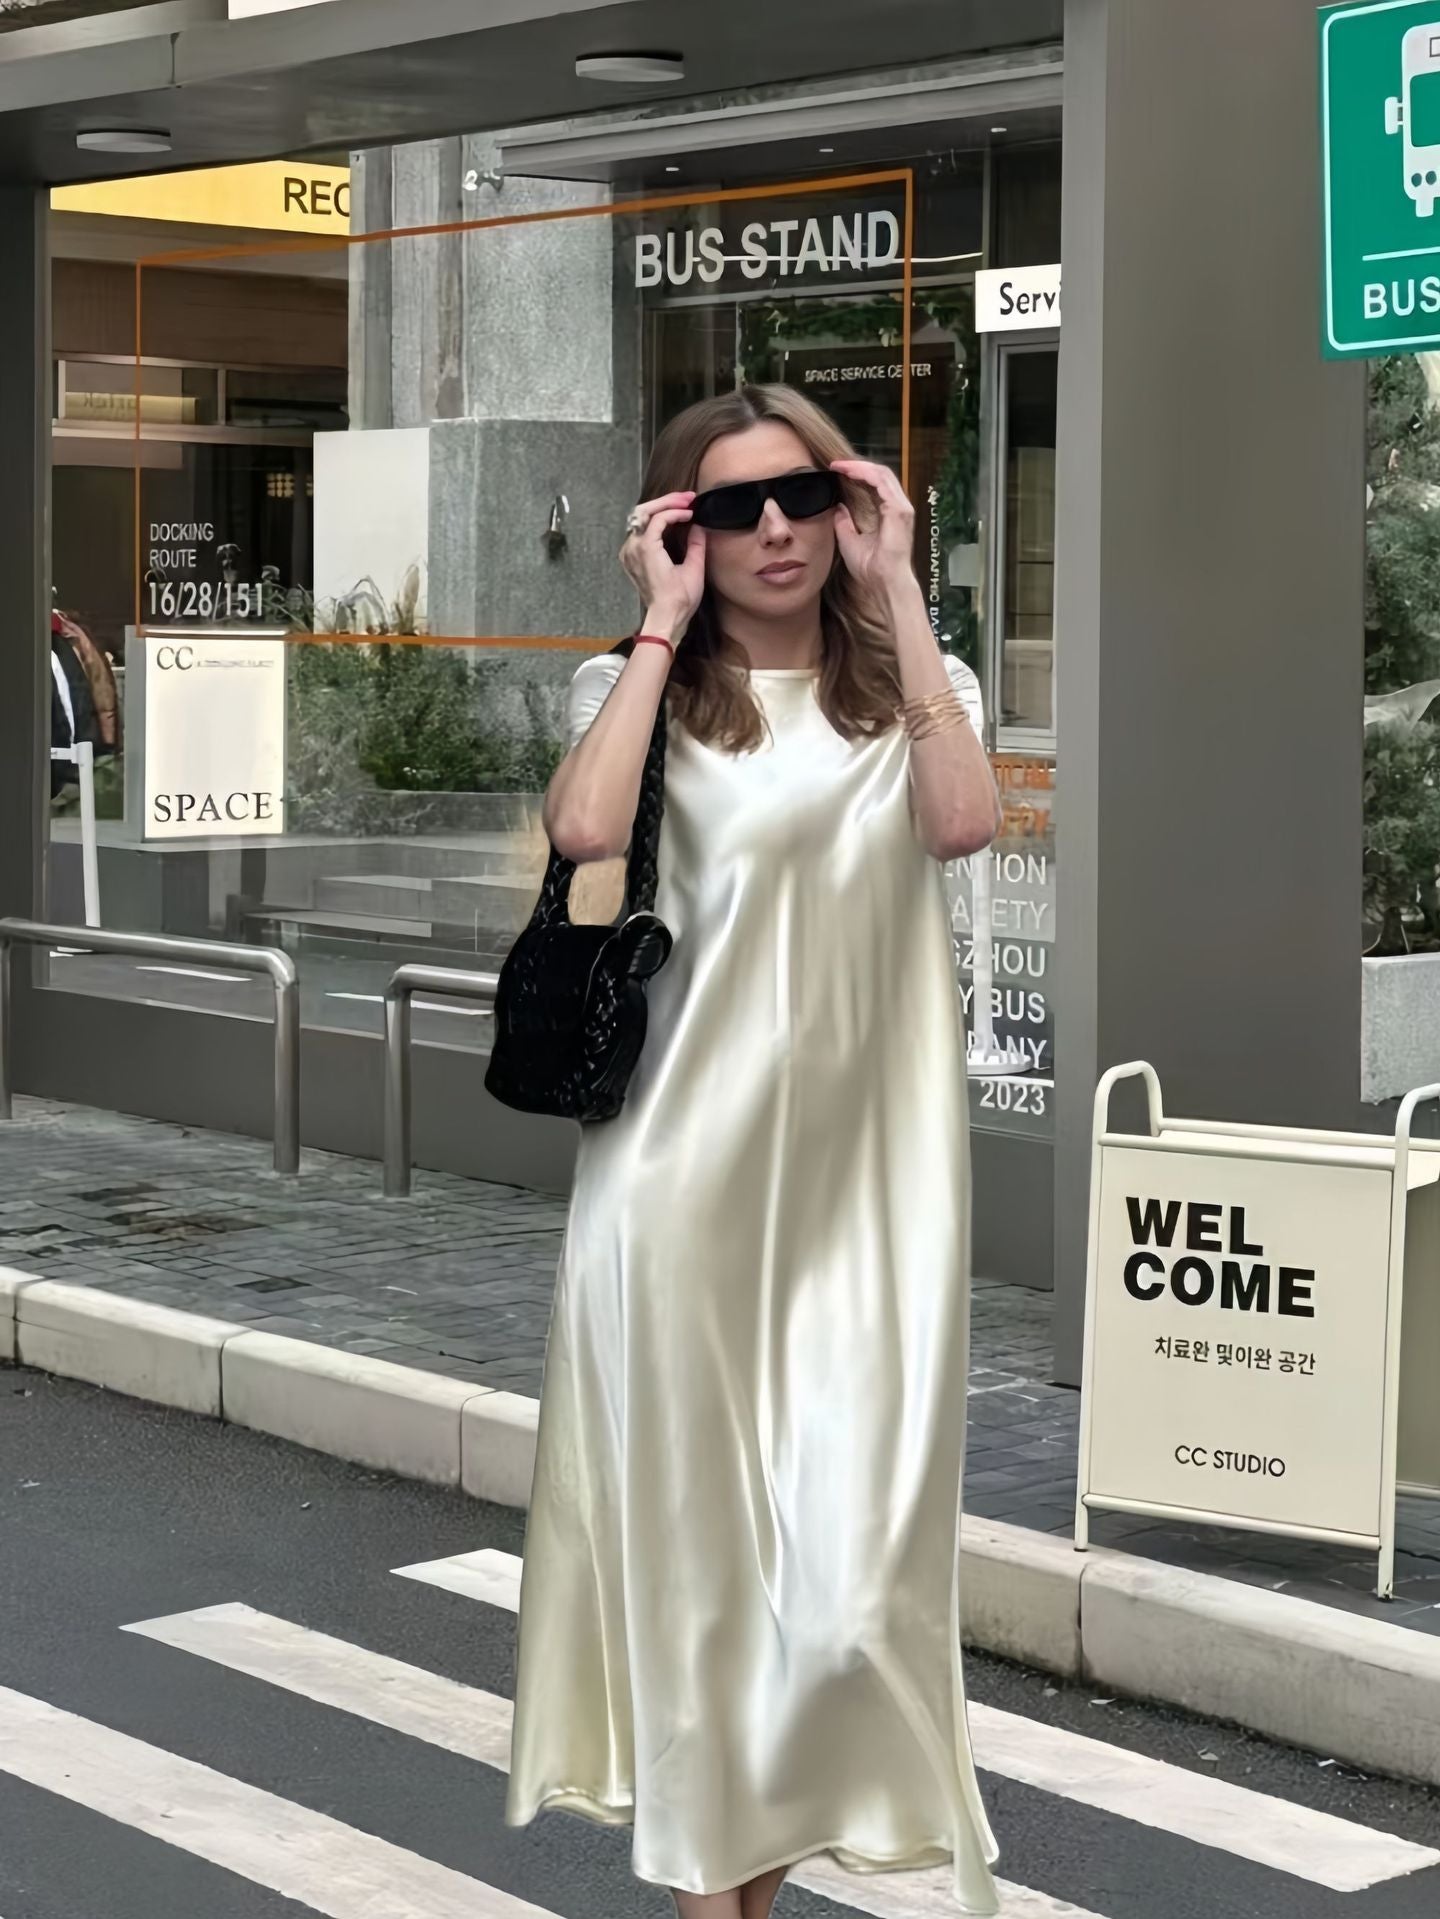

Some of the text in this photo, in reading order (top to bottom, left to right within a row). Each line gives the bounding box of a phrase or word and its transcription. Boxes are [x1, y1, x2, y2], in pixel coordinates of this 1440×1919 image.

[635, 210, 899, 287] BUS STAND
[1363, 276, 1440, 319] BUS
[840, 365, 886, 380] SERVICE
[887, 363, 931, 378] CETER
[150, 523, 214, 542] DOCKING
[149, 549, 197, 568] ROUTE
[149, 581, 263, 620] 16/28/151
[156, 646, 194, 670] CC
[154, 792, 273, 822] SPACE
[951, 895, 1049, 930] AETY
[979, 1080, 1046, 1116] 2023
[1125, 1196, 1264, 1257] WEL
[1123, 1251, 1316, 1318] COME
[1278, 1350, 1316, 1376] 공간
[1174, 1444, 1286, 1478] CC STUDIO
